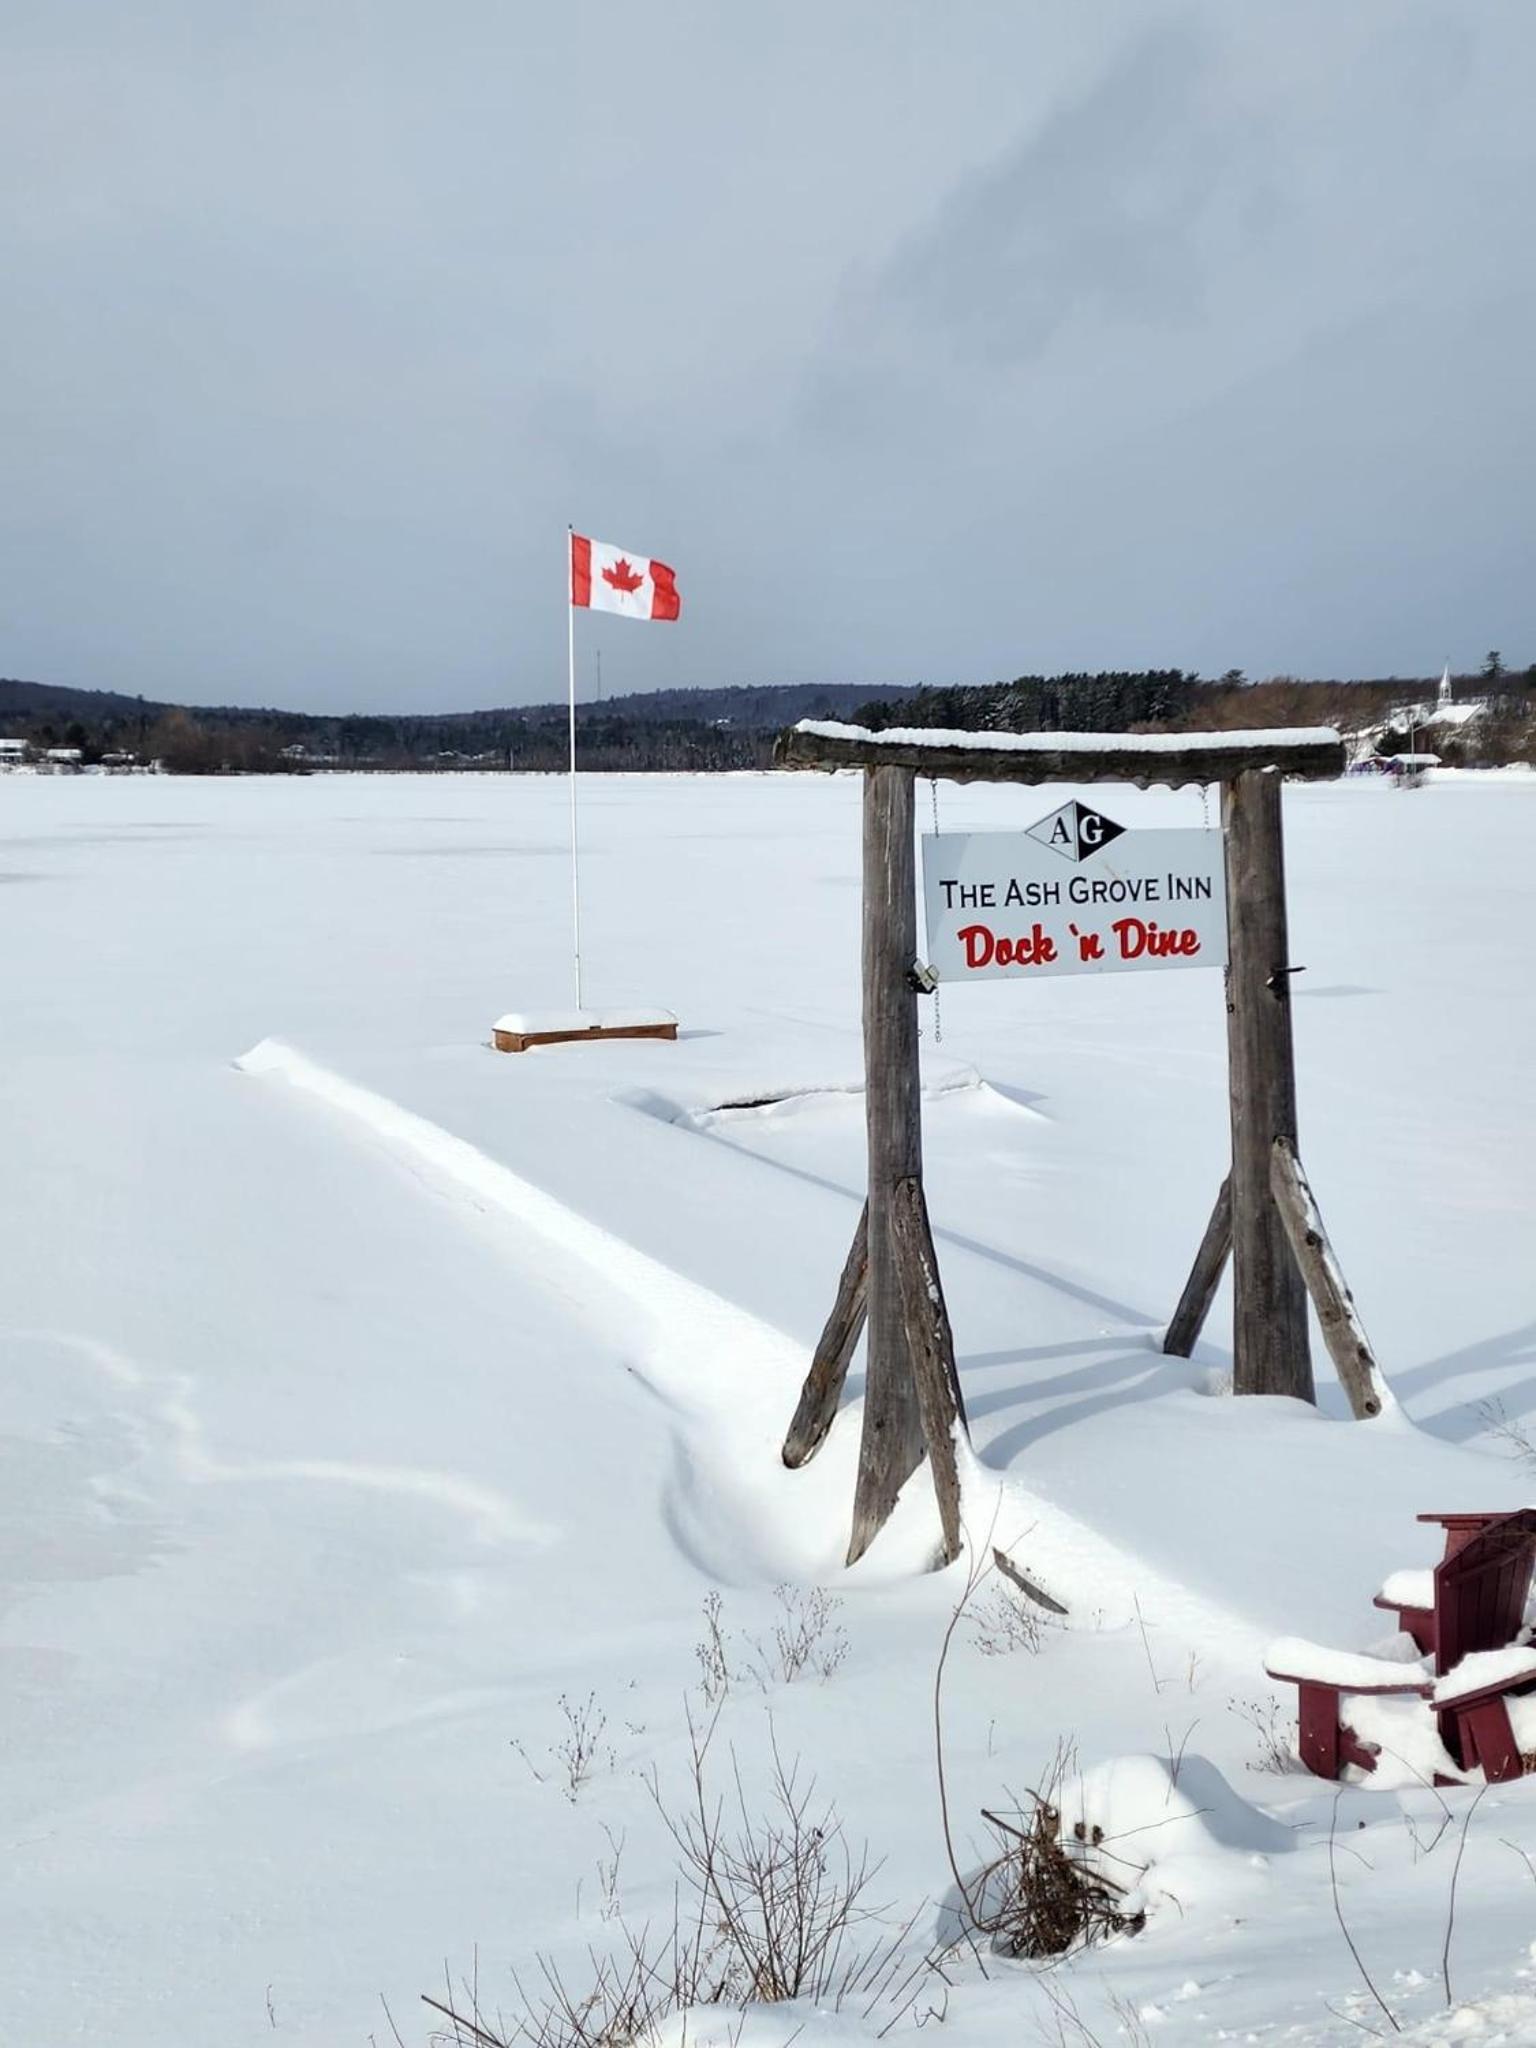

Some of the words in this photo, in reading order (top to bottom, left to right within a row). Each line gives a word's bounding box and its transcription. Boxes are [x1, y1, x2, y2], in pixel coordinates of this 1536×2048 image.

[939, 880, 996, 909] THE
[1004, 878, 1060, 907] ASH
[1068, 876, 1160, 903] GROVE
[1167, 873, 1212, 900] INN
[957, 923, 1059, 969] Dock
[1112, 917, 1201, 960] Dine
